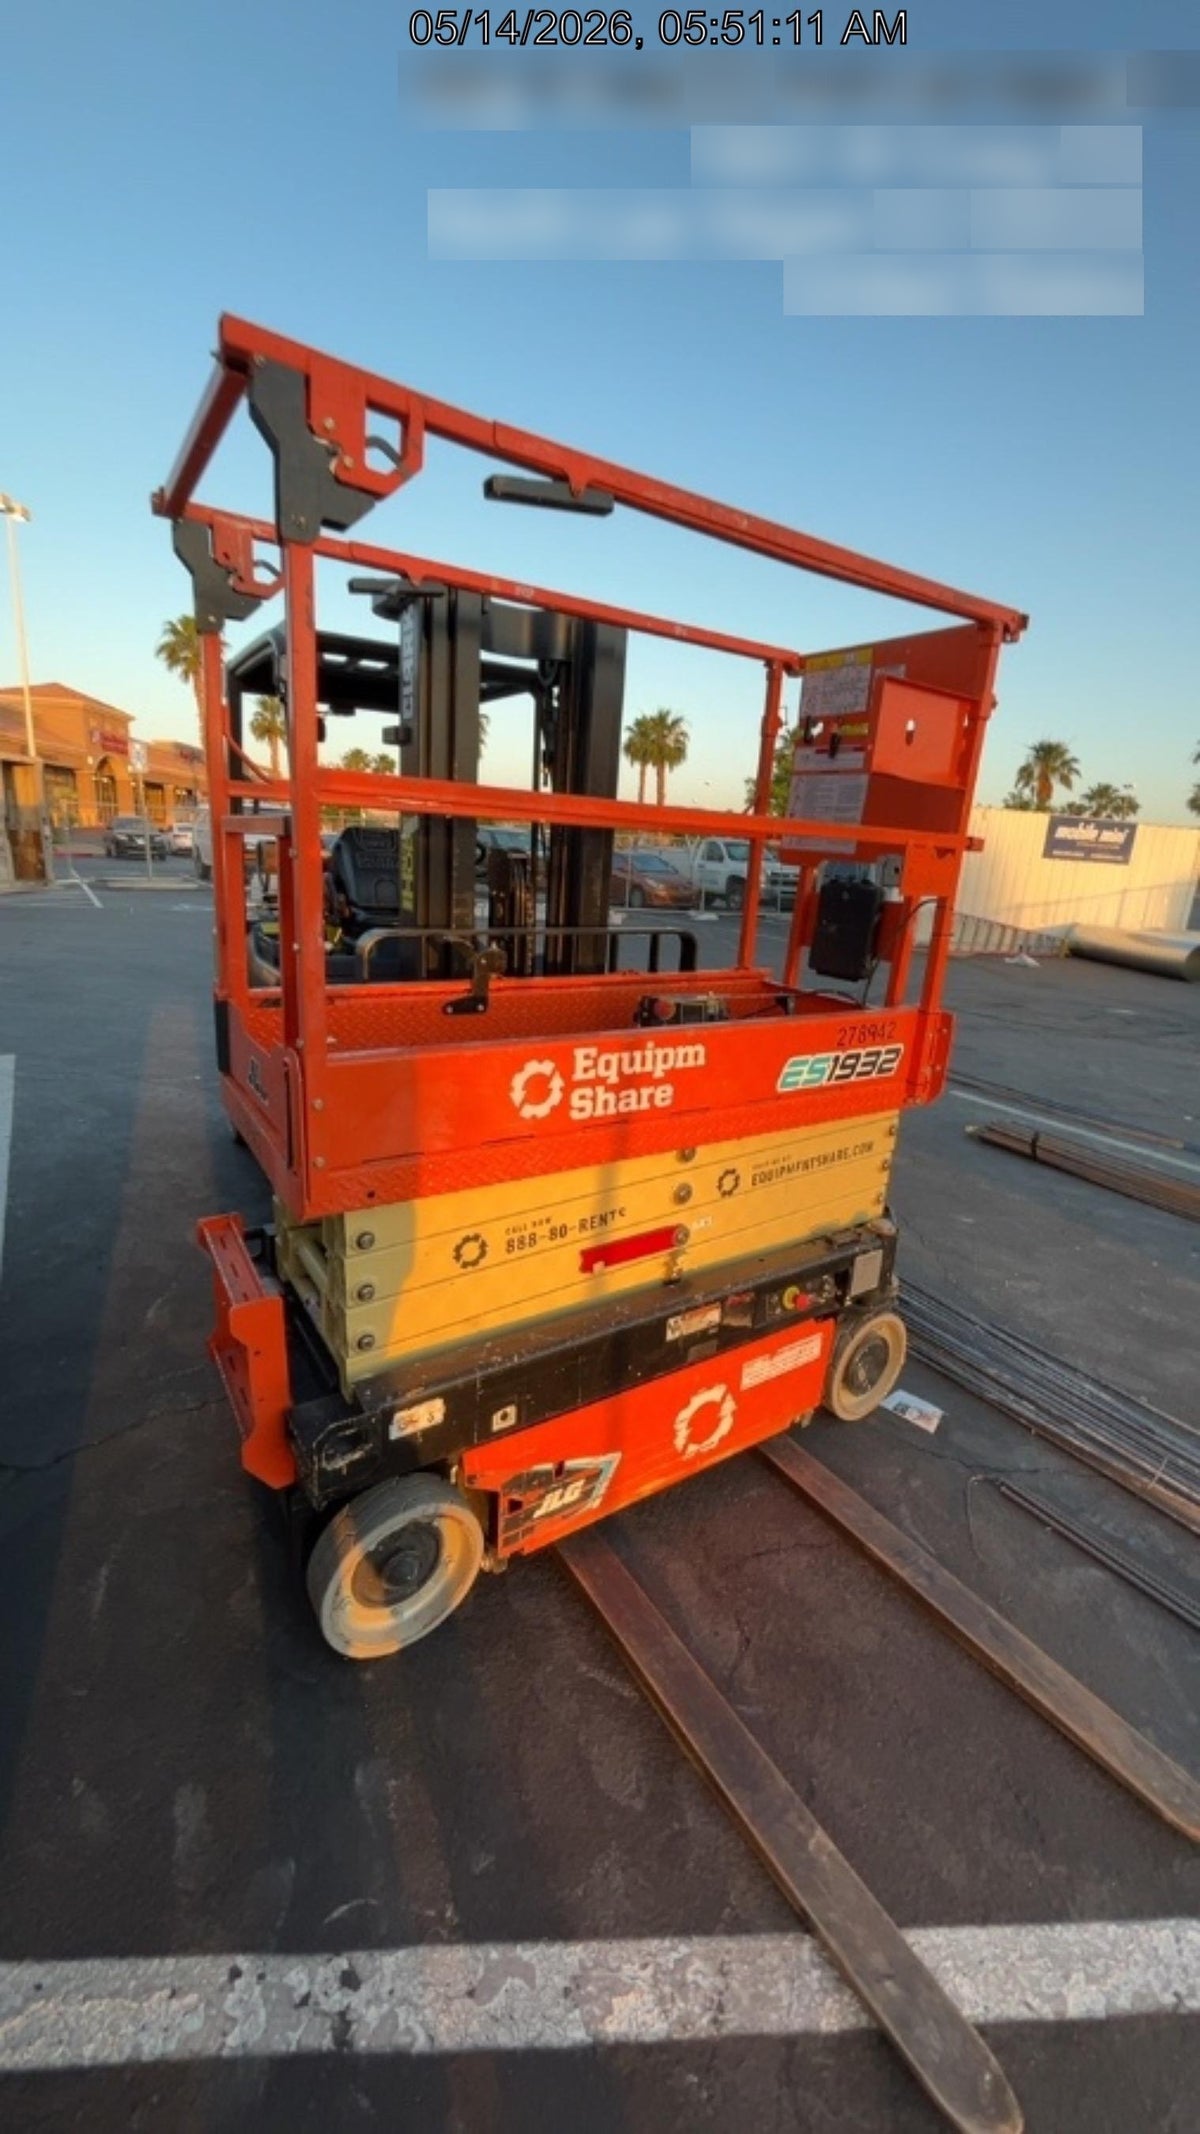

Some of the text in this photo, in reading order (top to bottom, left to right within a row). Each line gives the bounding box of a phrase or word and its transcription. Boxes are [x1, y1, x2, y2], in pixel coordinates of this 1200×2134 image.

[571, 1041, 706, 1085] Equipm
[778, 1045, 903, 1091] ES1932
[569, 1083, 675, 1120] Share
